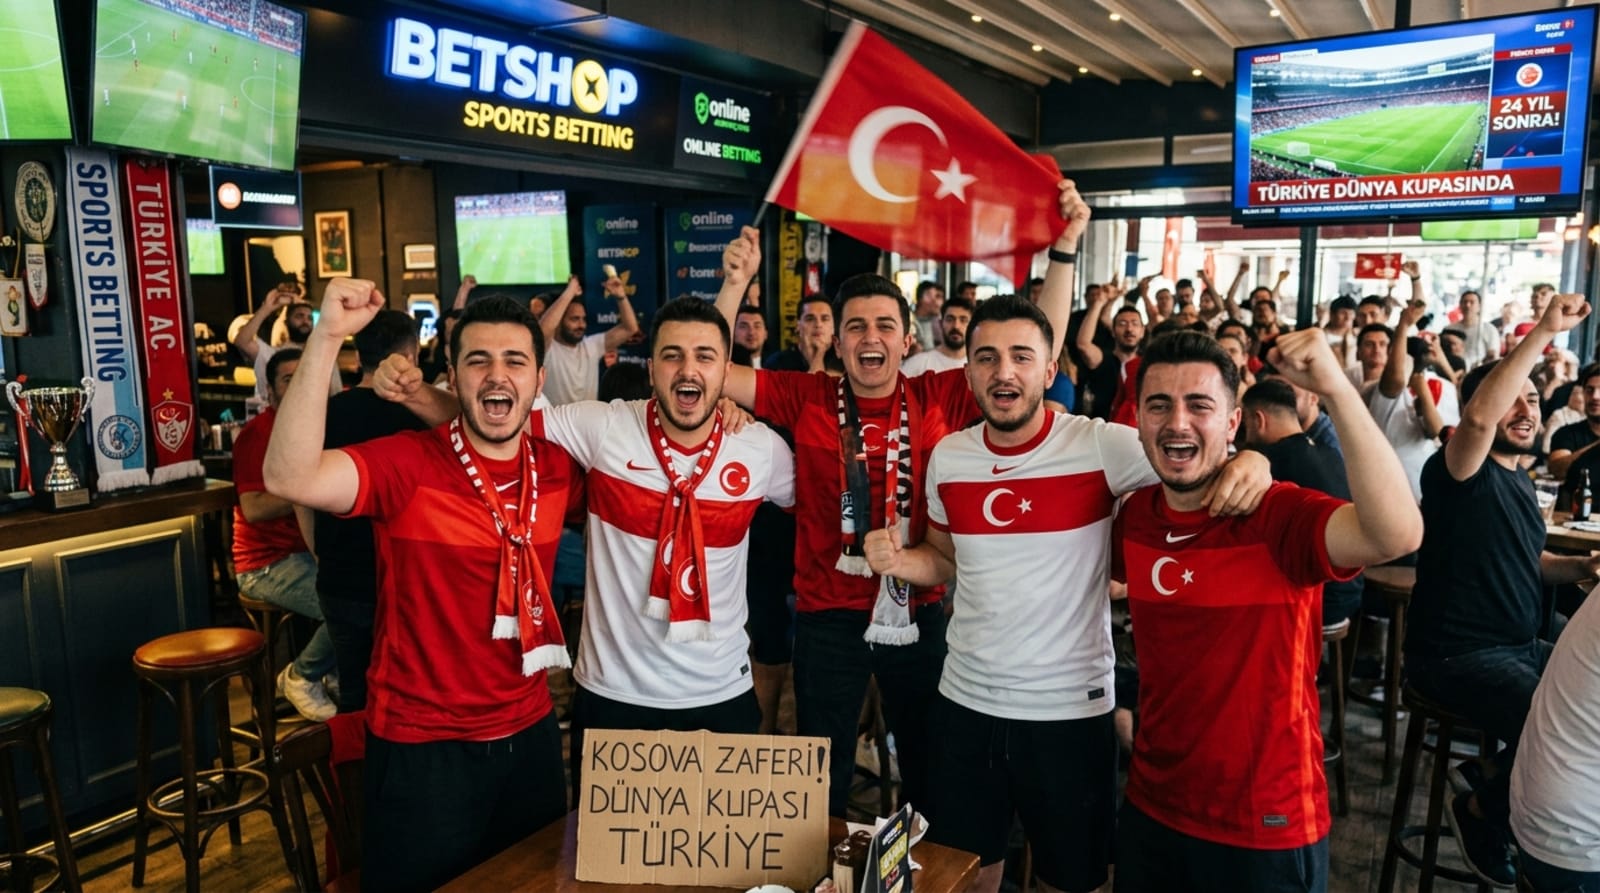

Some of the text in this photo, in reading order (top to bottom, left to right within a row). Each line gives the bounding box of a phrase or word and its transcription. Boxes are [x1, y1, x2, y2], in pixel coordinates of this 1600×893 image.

[388, 17, 638, 116] BETSHOP
[709, 98, 751, 123] online
[1500, 95, 1554, 113] 24 YIL
[463, 101, 634, 150] SPORTS BETTING
[1492, 112, 1560, 131] SONRA!
[683, 137, 762, 164] ONLINE BETTING
[1258, 174, 1514, 202] TÜRKİYE DÜNYA KUPASINDA
[77, 162, 116, 275] SPORTS
[605, 217, 639, 230] online
[691, 211, 734, 225] online
[135, 182, 176, 351] TÜRKİYE AC
[87, 276, 127, 383] BETTING
[592, 740, 703, 773] KOSOVA
[589, 779, 809, 820] DÜNYA KUPASI
[608, 822, 784, 871] TÜRKİYE
